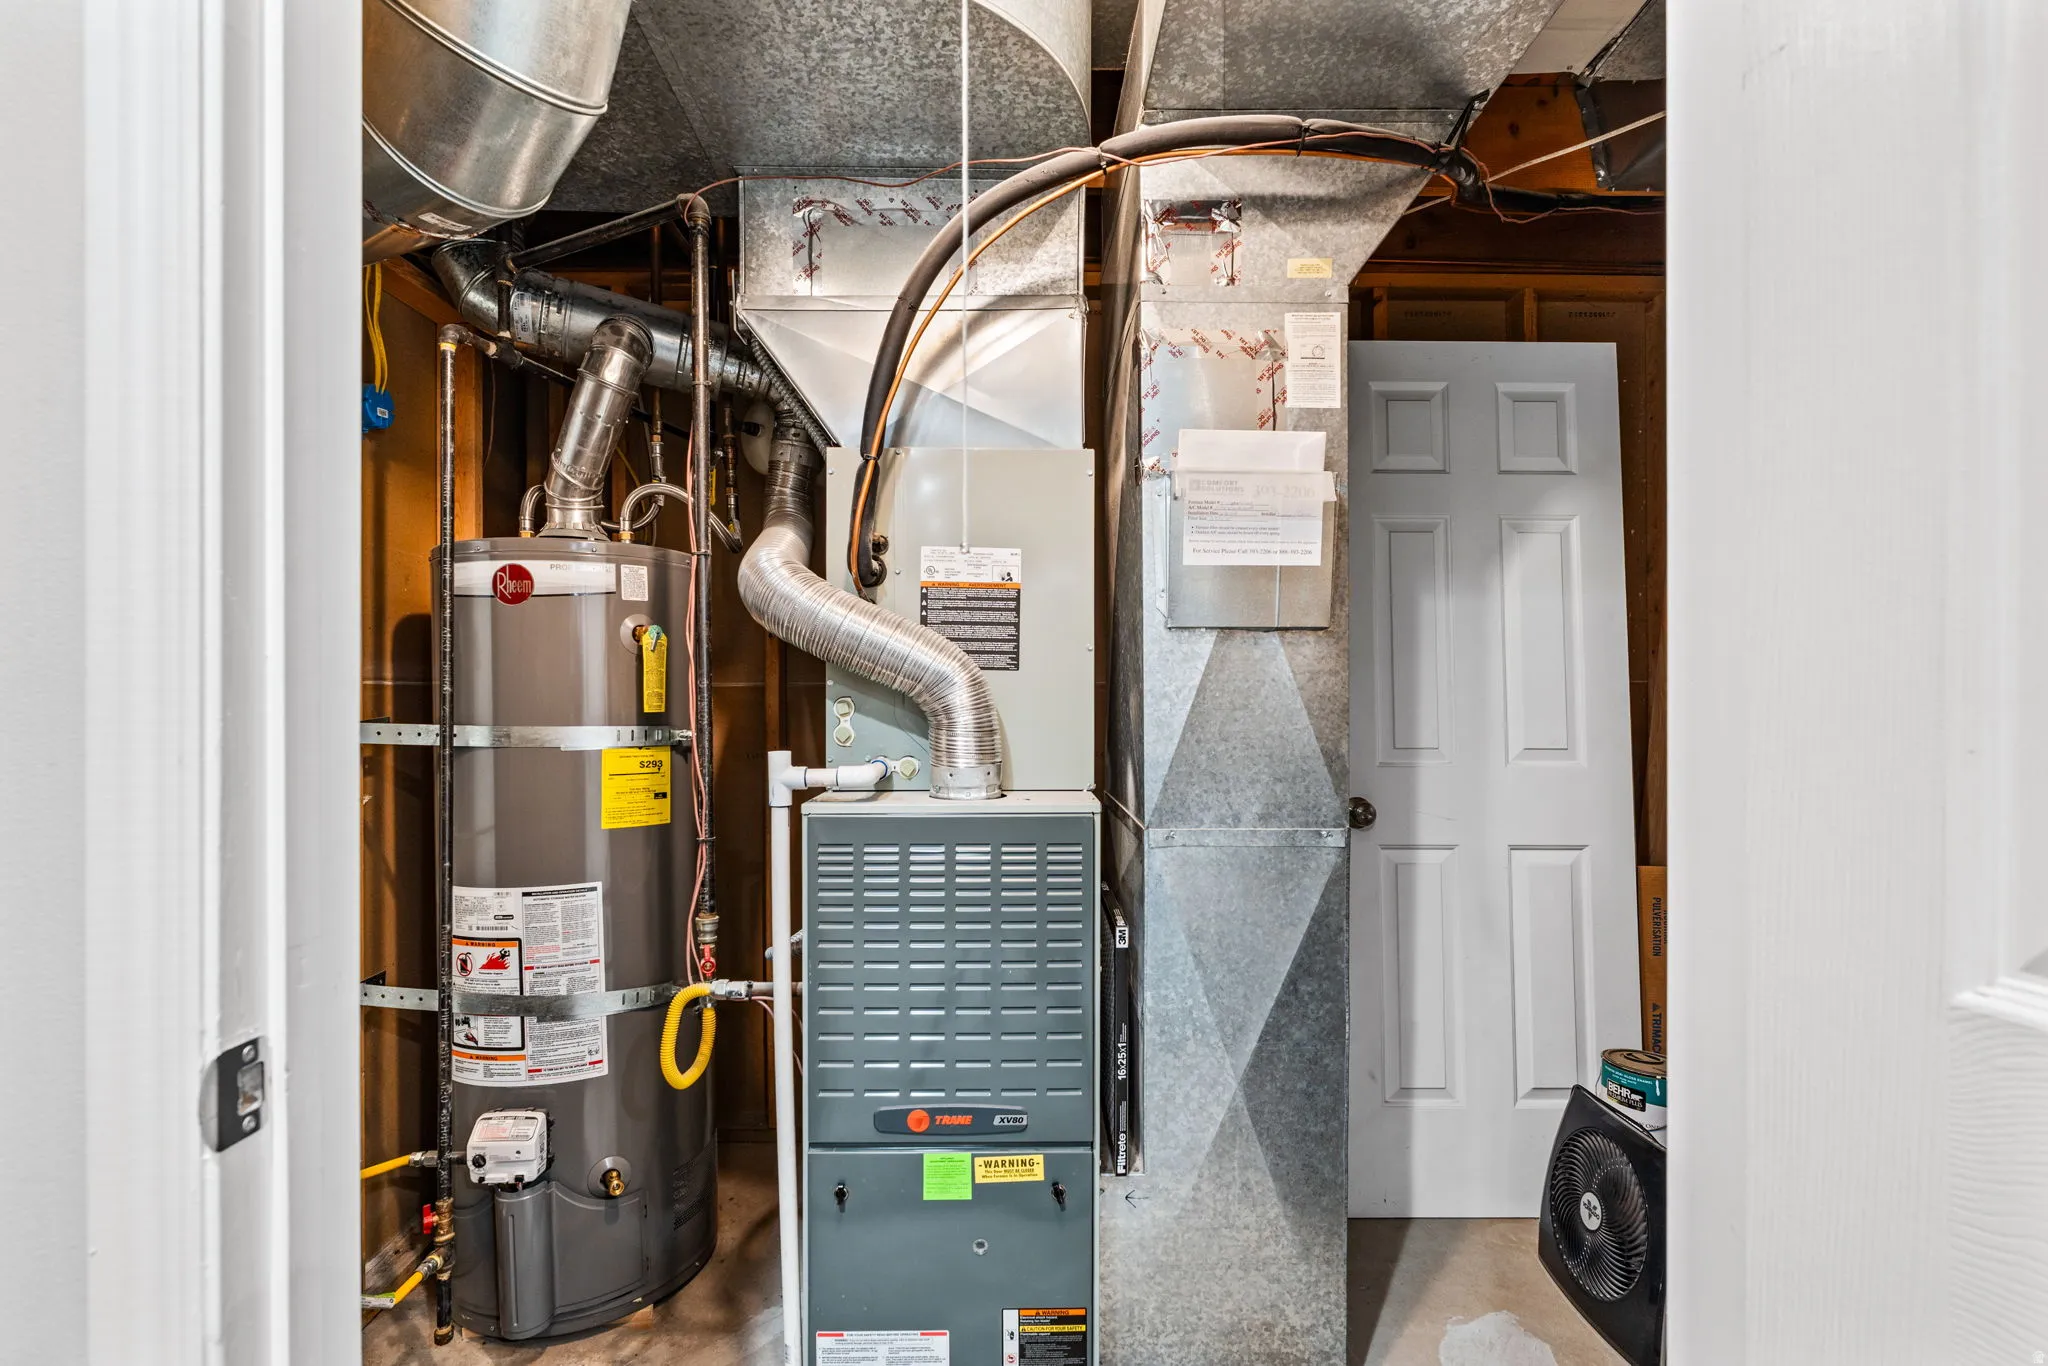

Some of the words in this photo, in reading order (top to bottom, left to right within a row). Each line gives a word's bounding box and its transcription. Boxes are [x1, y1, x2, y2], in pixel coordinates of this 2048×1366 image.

[496, 565, 532, 599] Rheem
[1118, 929, 1127, 945] 3M
[1117, 1043, 1127, 1081] 16x25x1
[1608, 1080, 1631, 1099] BEHR
[935, 1115, 973, 1125] TRANE
[998, 1116, 1024, 1124] XV80
[1117, 1132, 1127, 1174] Filtrete
